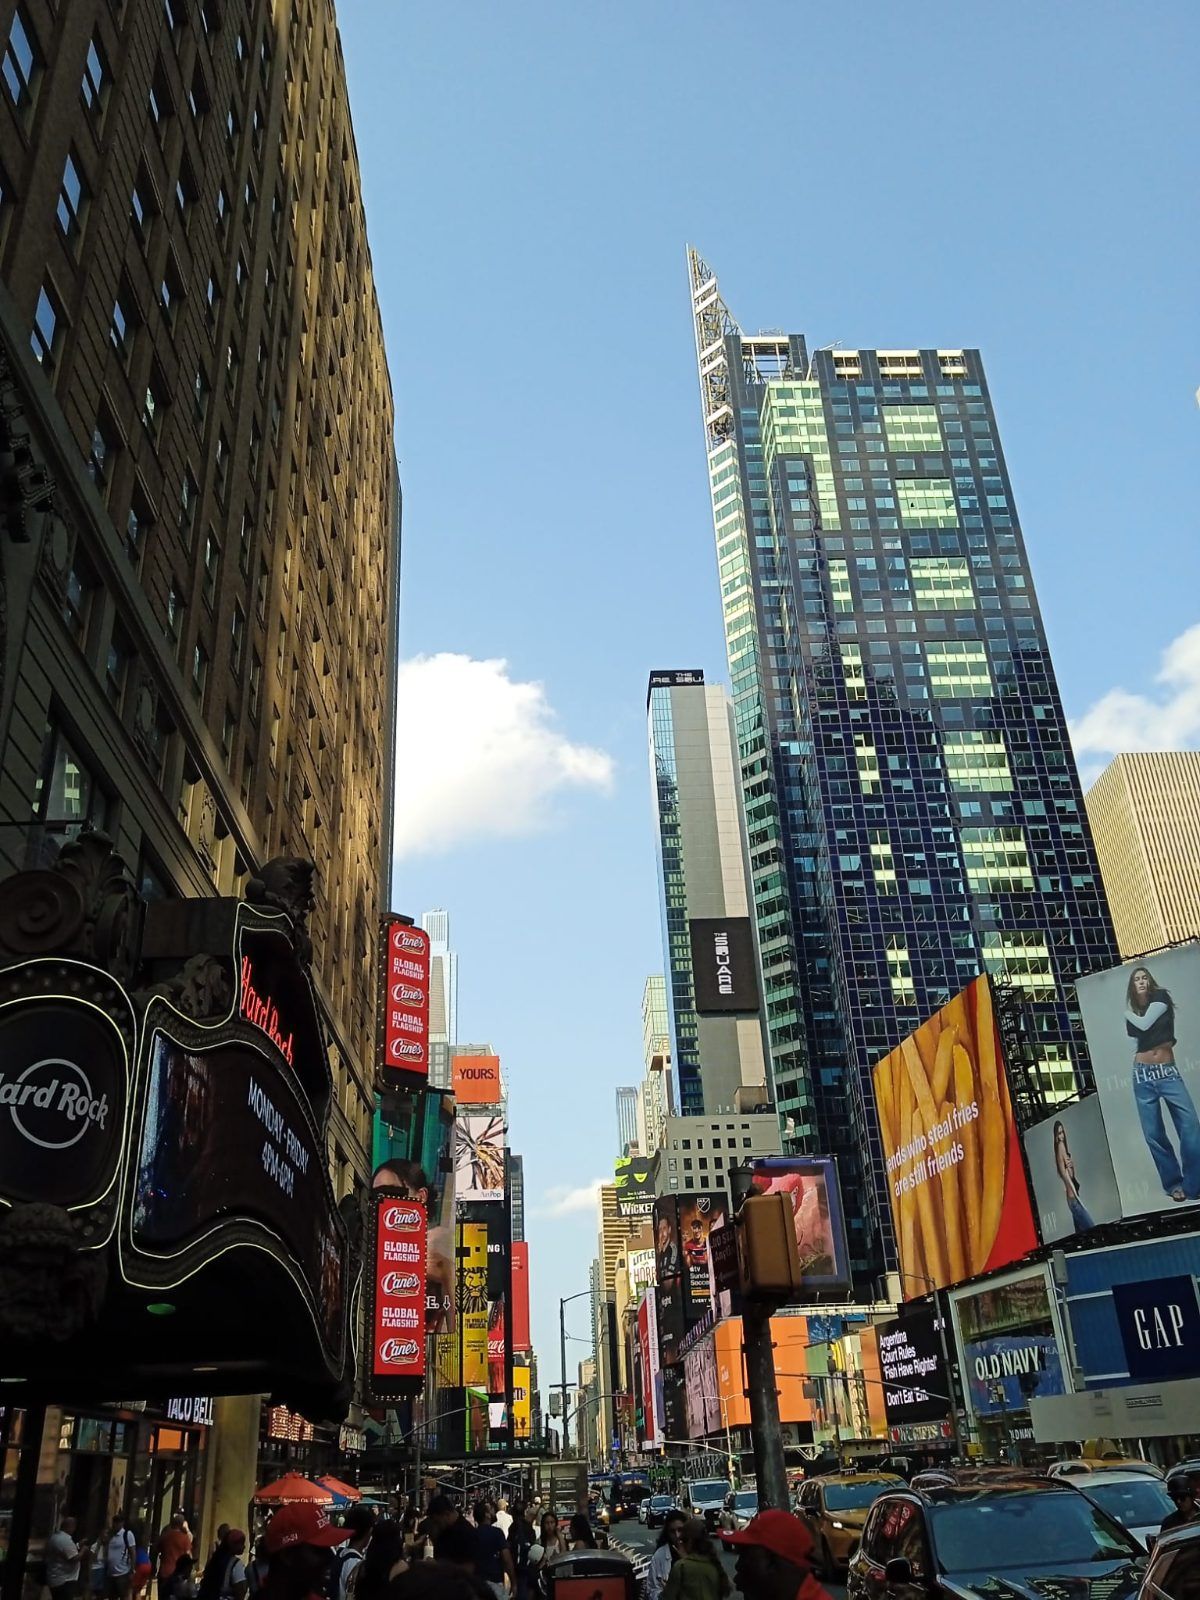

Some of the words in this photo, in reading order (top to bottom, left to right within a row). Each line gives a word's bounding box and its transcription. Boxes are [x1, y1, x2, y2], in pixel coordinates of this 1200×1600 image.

[394, 931, 424, 948] Cane's
[394, 958, 424, 973] GLOBAL
[394, 966, 424, 980] FLAGSHIP
[716, 937, 734, 994] SQUARE
[392, 984, 424, 1001] Cane's
[241, 956, 271, 1034] Hard
[269, 1006, 293, 1067] Rock
[392, 1011, 423, 1026] GLOBAL
[392, 1020, 424, 1034] FLAGSHIP
[391, 1038, 422, 1054] Cane's
[460, 1068, 496, 1080] YOURS.
[1134, 1063, 1178, 1083] Hailey
[0, 1073, 59, 1108] ard
[57, 1082, 108, 1130] Rock
[248, 1076, 284, 1144] MONDAY
[286, 1127, 310, 1175] FRIDAY
[907, 1134, 926, 1159] who
[928, 1112, 952, 1146] steal
[953, 1101, 979, 1130] fries
[894, 1176, 908, 1197] are
[909, 1161, 927, 1188] still
[928, 1141, 964, 1177] friends
[384, 1207, 420, 1228] Cane's
[384, 1241, 420, 1254] GLOBAL
[384, 1252, 420, 1262] FLAGSHIP
[634, 1250, 655, 1266] LITTLE
[383, 1272, 419, 1293] Cane's
[382, 1307, 418, 1318] GLOBAL
[382, 1317, 419, 1328] FLAGSHIP
[1134, 1304, 1184, 1350] GAP
[880, 1330, 907, 1350] Argentina
[381, 1338, 418, 1360] Cane's
[882, 1348, 898, 1364] Court
[898, 1346, 916, 1361] Rules
[898, 1362, 913, 1377] Have
[975, 1354, 1000, 1381] OLD
[1002, 1346, 1039, 1376] NAVY
[886, 1390, 903, 1406] Don't
[903, 1390, 914, 1404] Eat
[193, 1397, 214, 1426] BELL
[1020, 1428, 1034, 1440] NAVY
